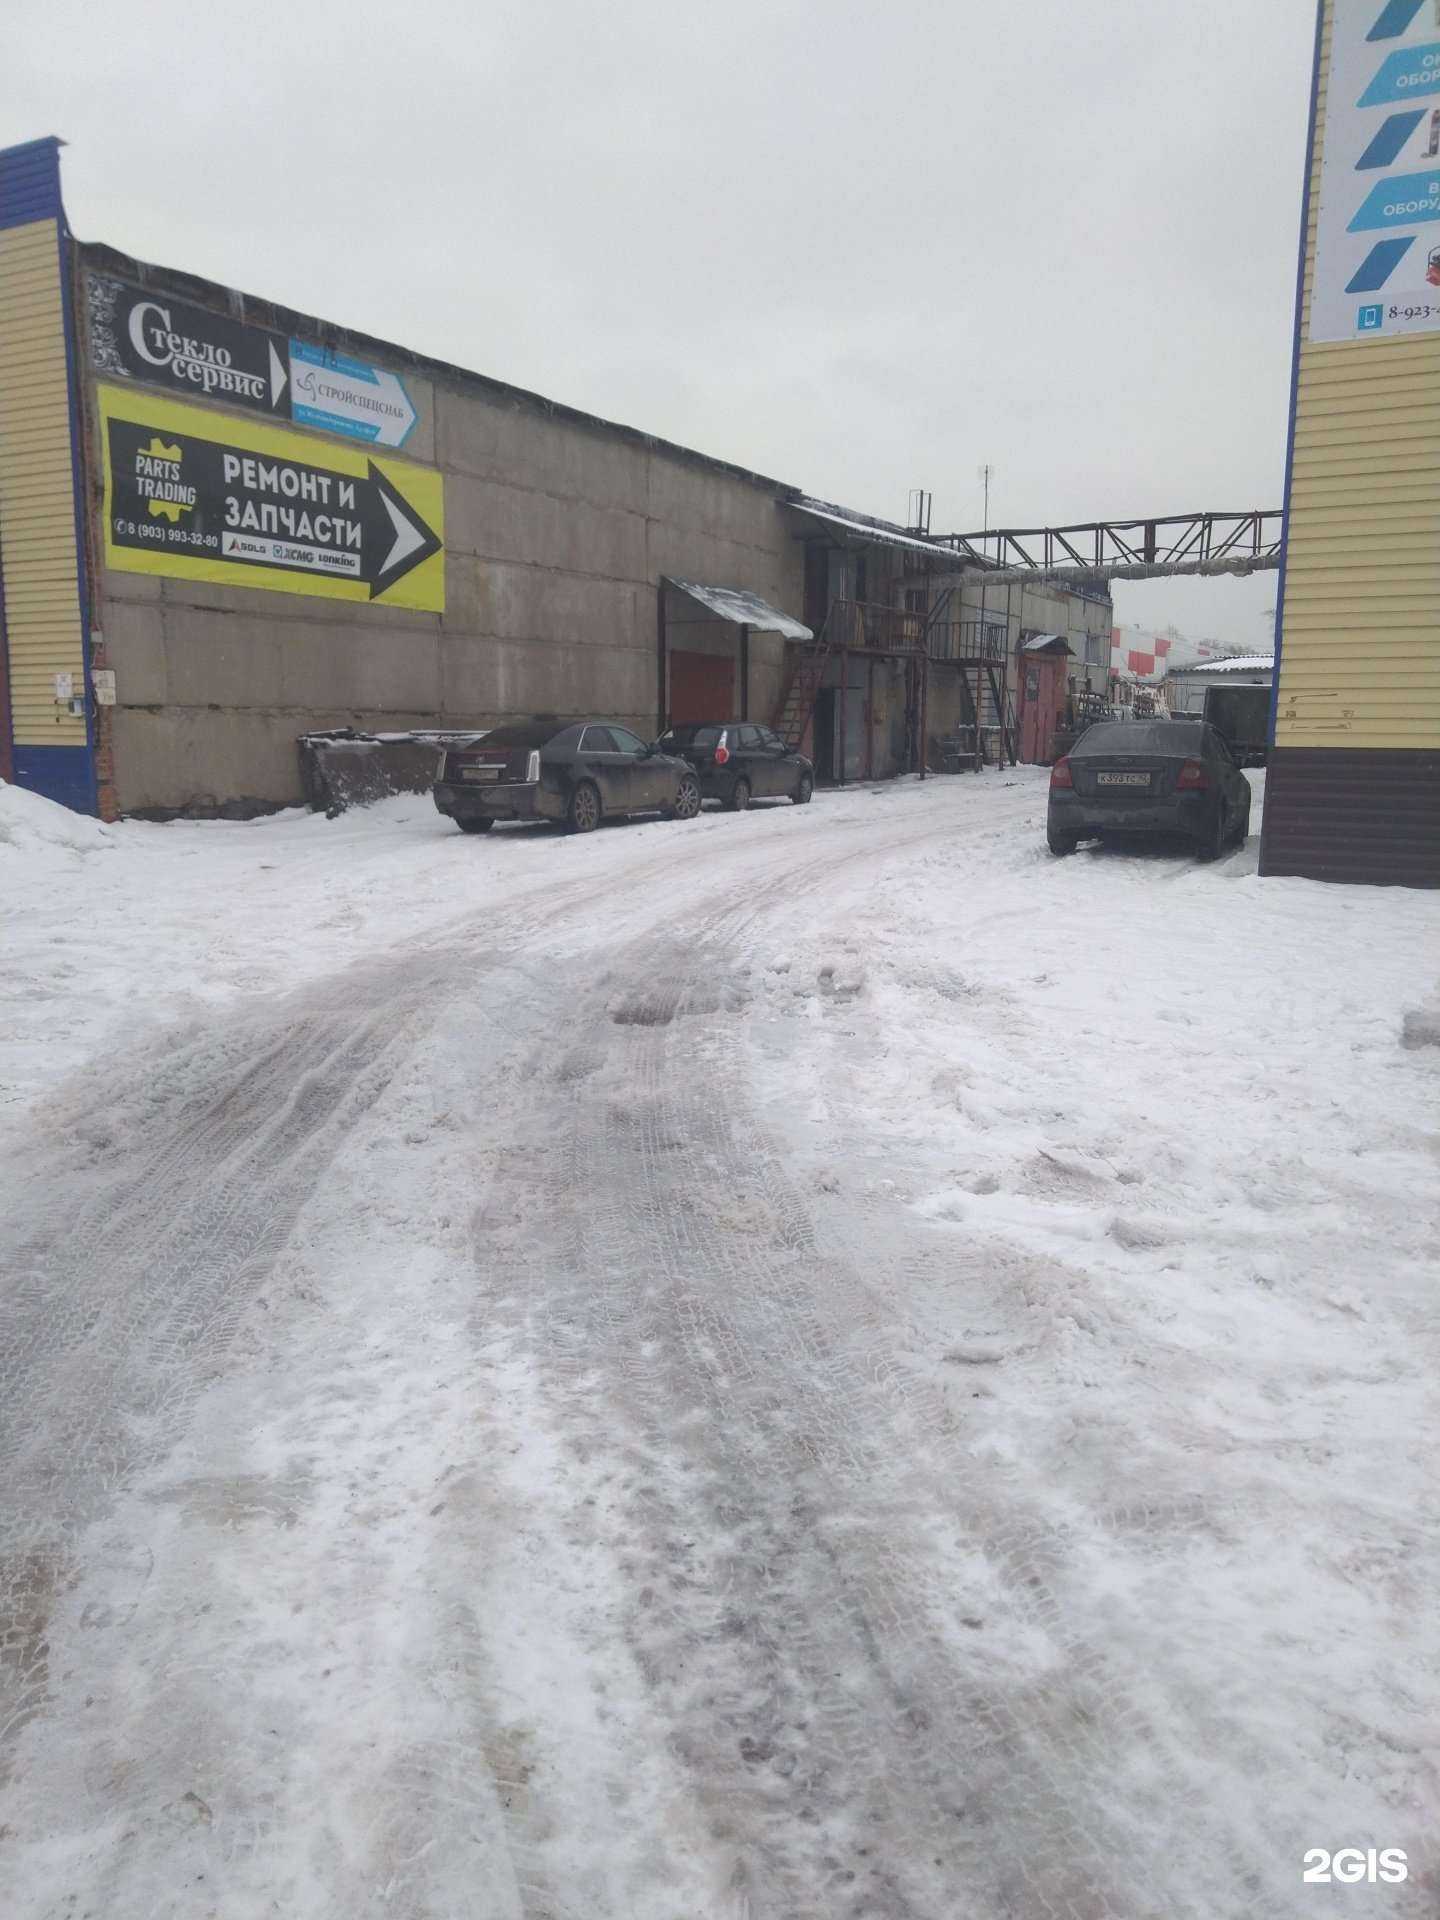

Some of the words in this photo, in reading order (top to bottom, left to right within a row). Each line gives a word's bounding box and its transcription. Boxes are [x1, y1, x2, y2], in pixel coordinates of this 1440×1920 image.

[1383, 197, 1440, 216] ОБОРУ
[128, 302, 232, 367] Стекло
[171, 356, 265, 400] сервис
[318, 384, 404, 418] СТРОЙСПЕЦСНАБ
[135, 455, 180, 481] PARTS
[223, 454, 331, 505] РЕМОНТ
[338, 483, 355, 510] И
[136, 476, 196, 505] TRADING
[128, 522, 135, 535] 8
[138, 524, 165, 541] (903)
[168, 529, 218, 547] 993-32-80
[224, 496, 361, 549] ЗАПЧАСТИ
